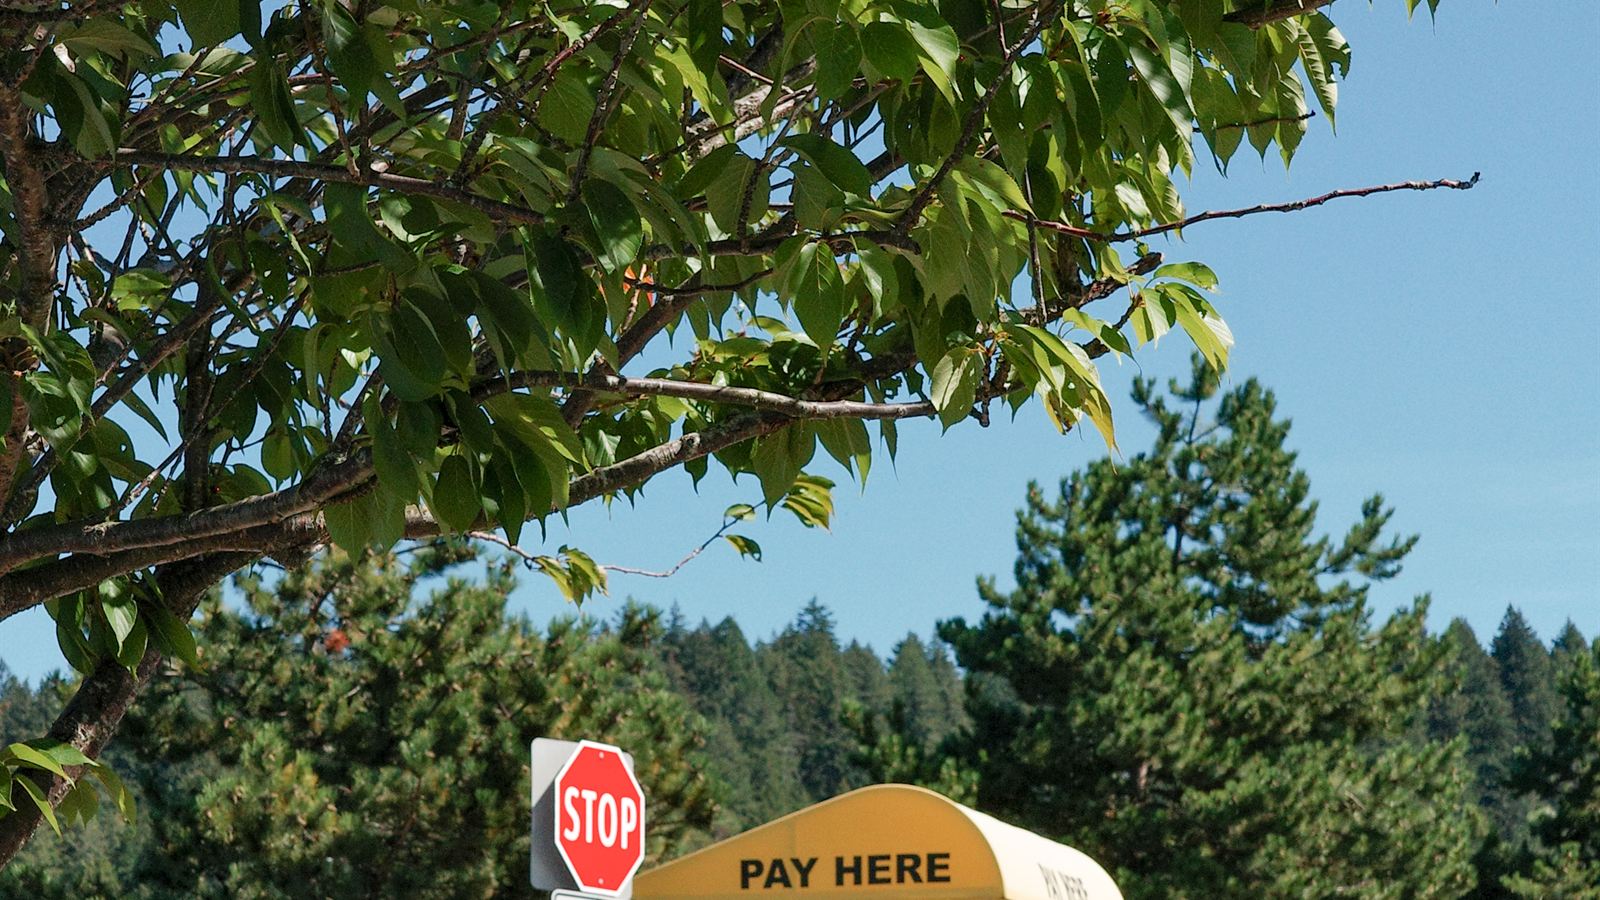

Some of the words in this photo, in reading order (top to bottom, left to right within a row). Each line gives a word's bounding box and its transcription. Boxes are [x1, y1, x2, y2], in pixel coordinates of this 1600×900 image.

[563, 786, 637, 850] STOP
[740, 857, 818, 889] PAY
[835, 852, 951, 886] HERE
